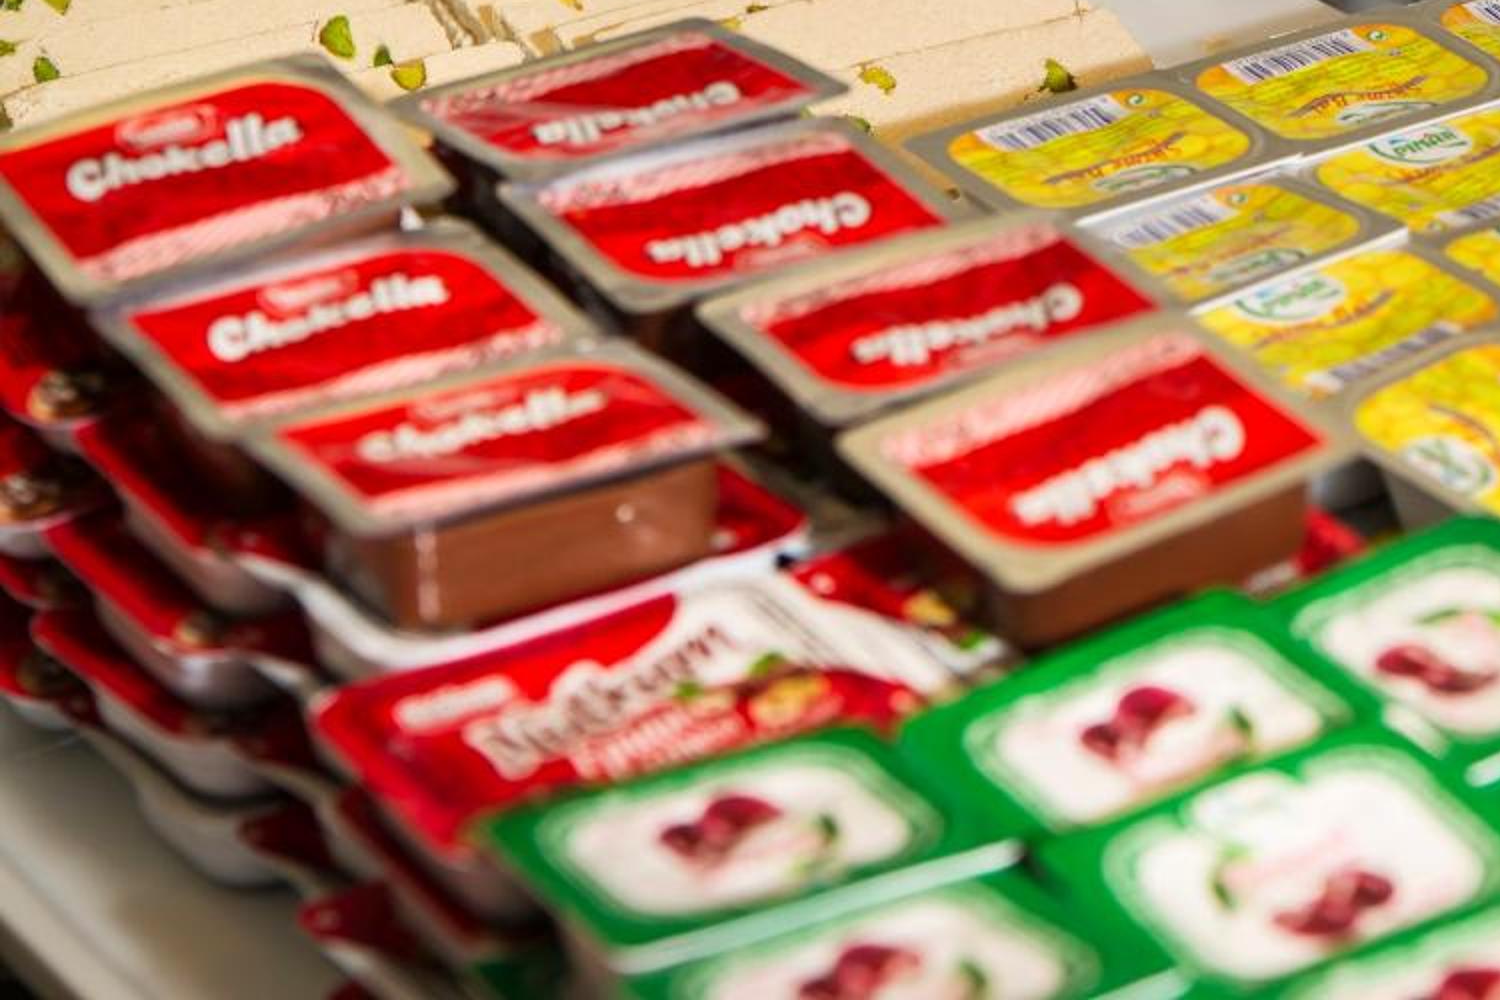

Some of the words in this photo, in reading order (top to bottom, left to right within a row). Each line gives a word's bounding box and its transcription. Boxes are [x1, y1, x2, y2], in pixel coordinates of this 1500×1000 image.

[66, 110, 303, 202] Chokella
[645, 190, 873, 267] Chokella
[205, 274, 450, 363] Chokella
[850, 281, 1085, 365] Chokella
[355, 388, 607, 465] Chokella
[1008, 404, 1247, 525] Chokella
